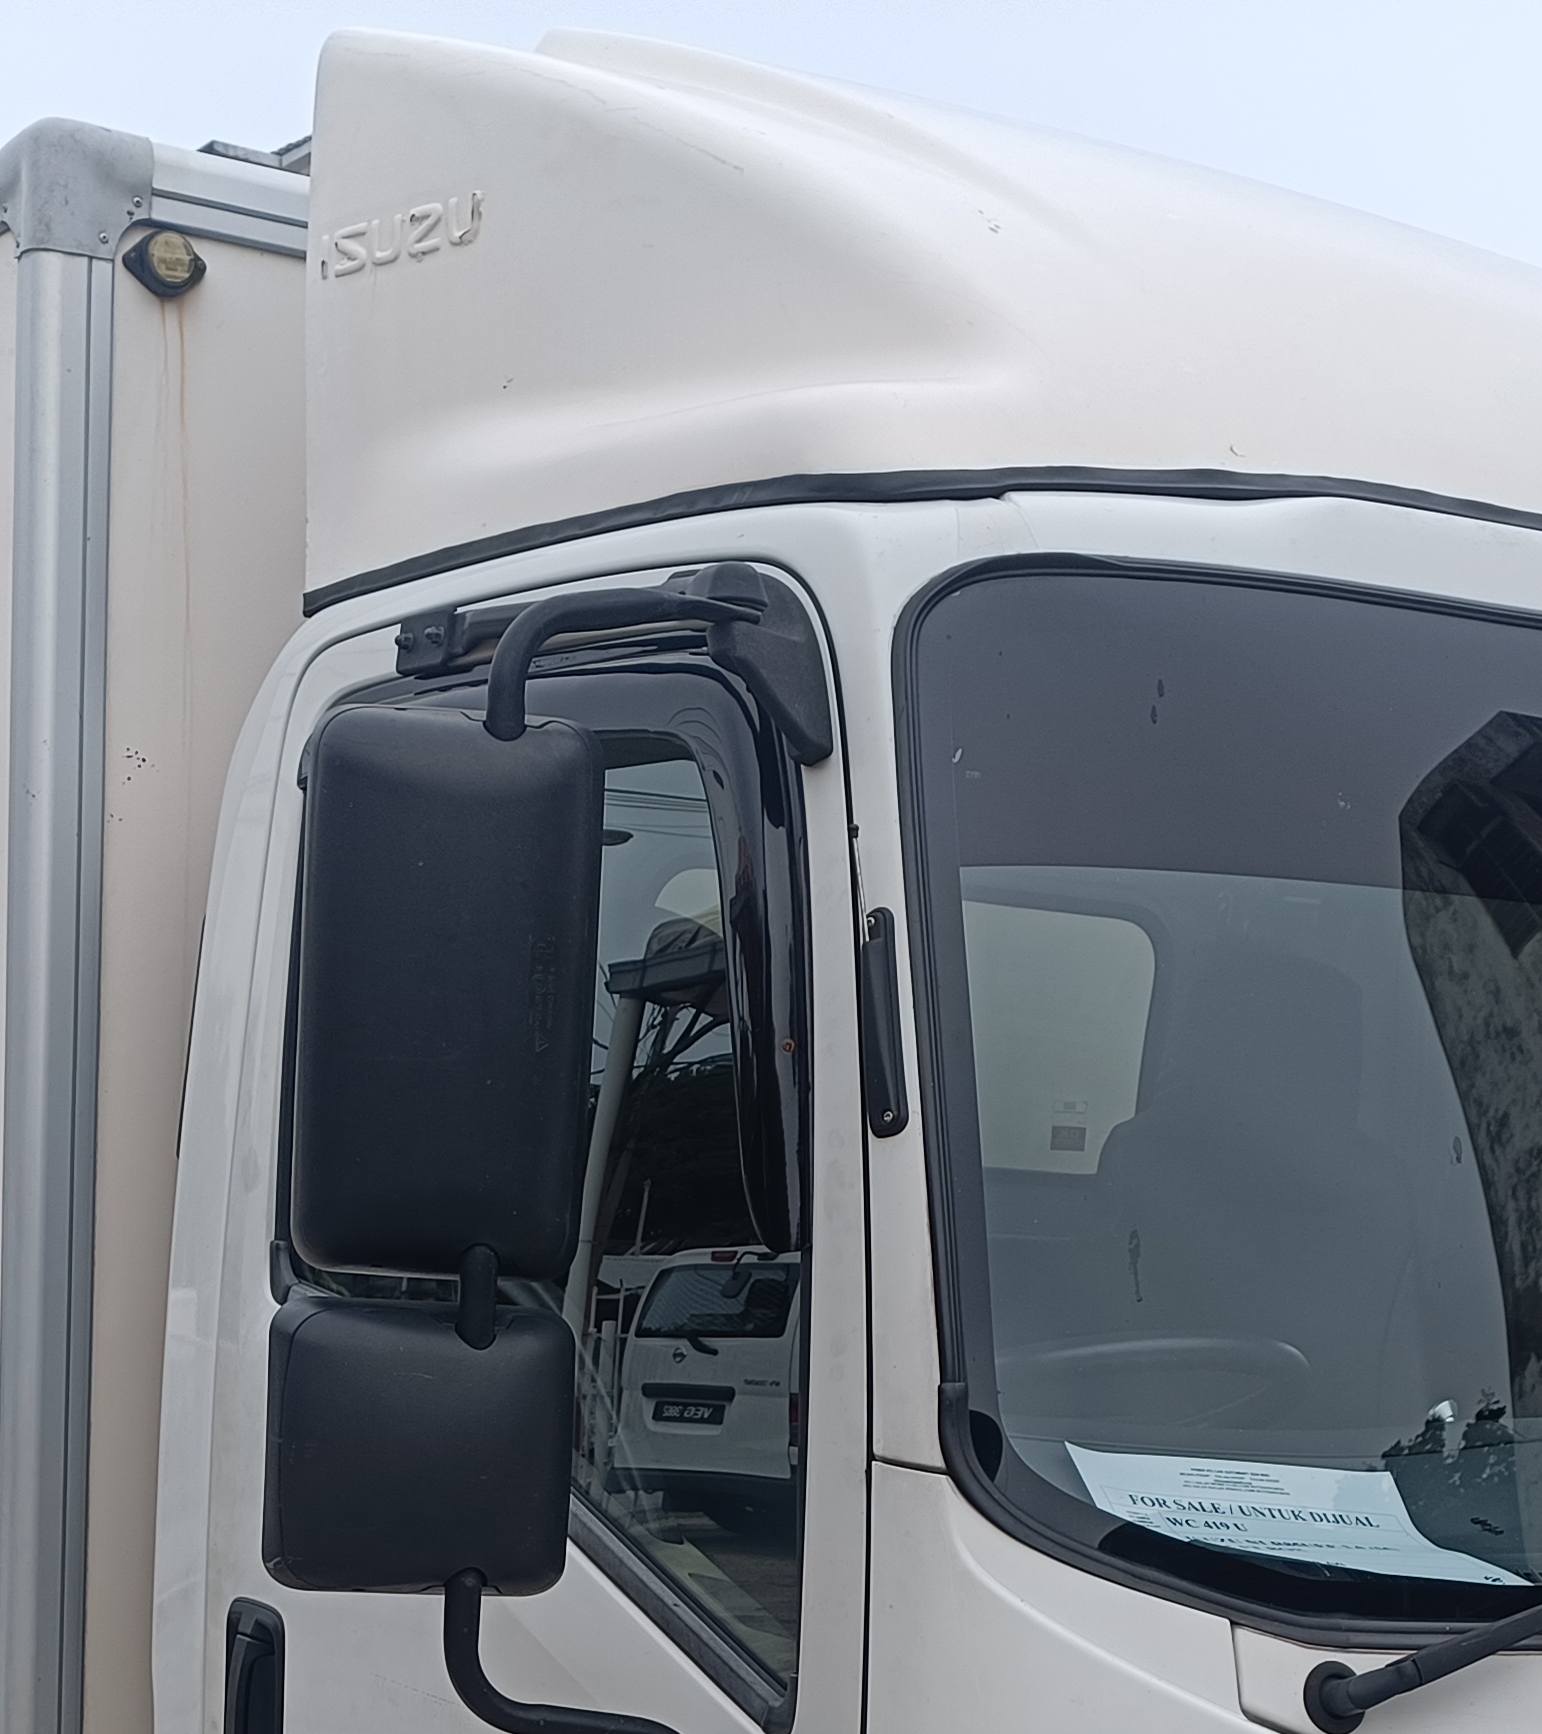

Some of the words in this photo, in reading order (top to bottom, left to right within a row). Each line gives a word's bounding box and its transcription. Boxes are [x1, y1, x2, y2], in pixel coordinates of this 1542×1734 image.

[321, 190, 485, 280] ISUZU
[1128, 1493, 1171, 1510] FOR
[1173, 1499, 1226, 1516] SALE
[1240, 1505, 1307, 1523] UNTUK
[1308, 1511, 1380, 1529] DIJUAL
[1165, 1516, 1200, 1529] WC
[1203, 1519, 1230, 1531] 419
[1233, 1522, 1249, 1533] U
